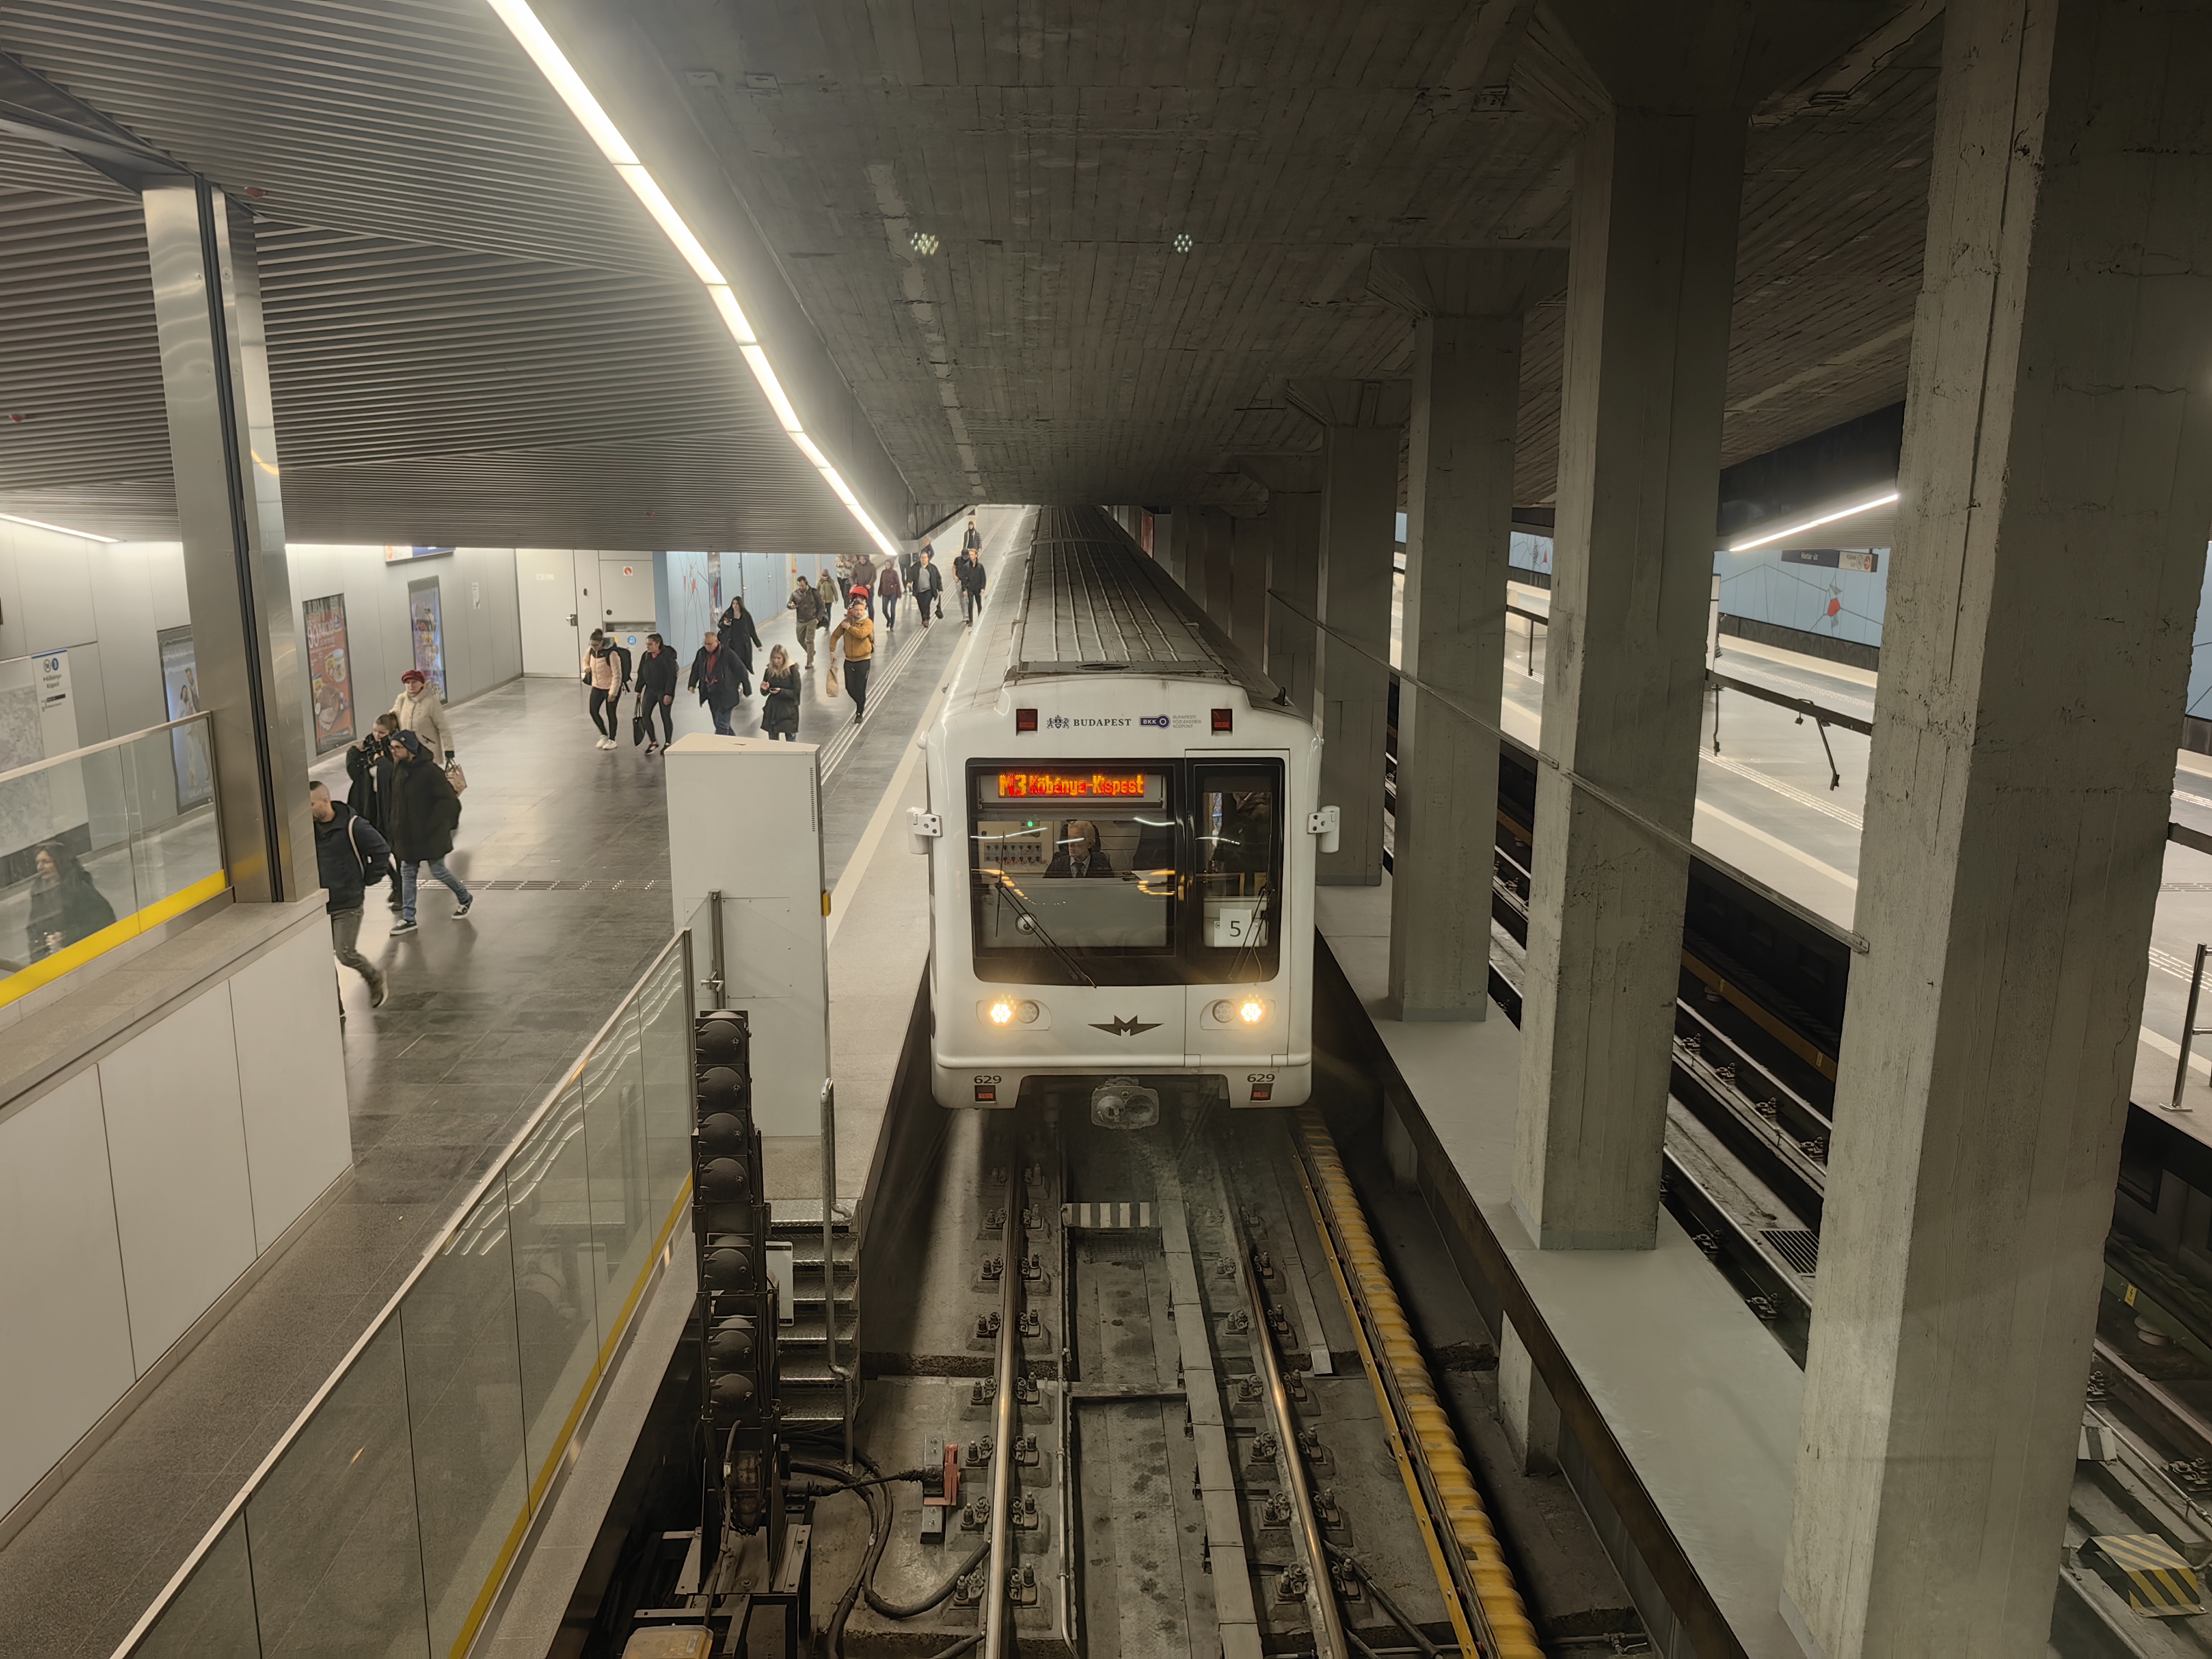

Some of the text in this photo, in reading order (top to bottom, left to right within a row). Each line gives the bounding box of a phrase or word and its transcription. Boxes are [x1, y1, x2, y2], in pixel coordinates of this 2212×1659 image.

[1073, 718, 1131, 726] BUDAPEST
[1000, 774, 1026, 797] M3
[1230, 920, 1240, 937] 5
[974, 1075, 1002, 1084] 629
[1247, 1073, 1275, 1083] 629
